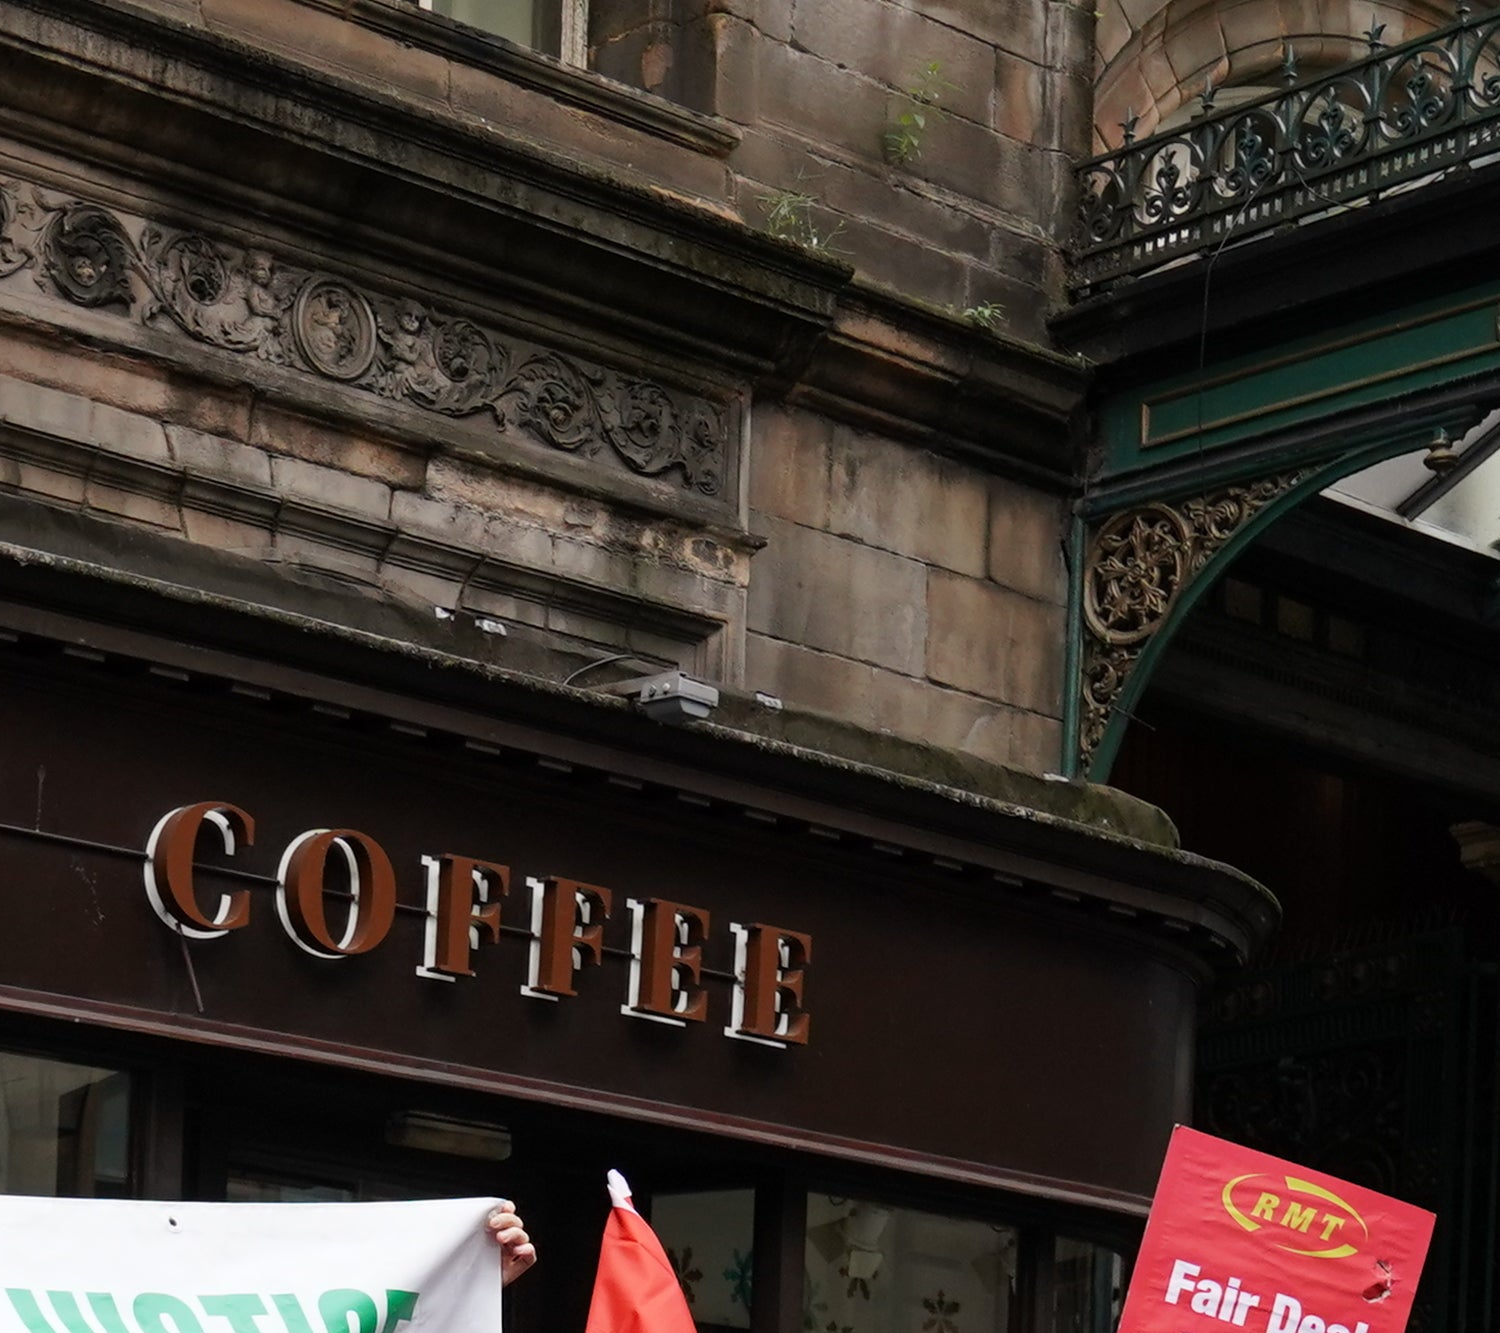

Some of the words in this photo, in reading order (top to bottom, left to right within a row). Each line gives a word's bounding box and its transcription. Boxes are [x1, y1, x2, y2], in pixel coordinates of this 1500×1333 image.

[144, 800, 812, 1049] COFFEE
[1251, 1190, 1346, 1242] RMT
[1164, 1260, 1260, 1327] Fair
